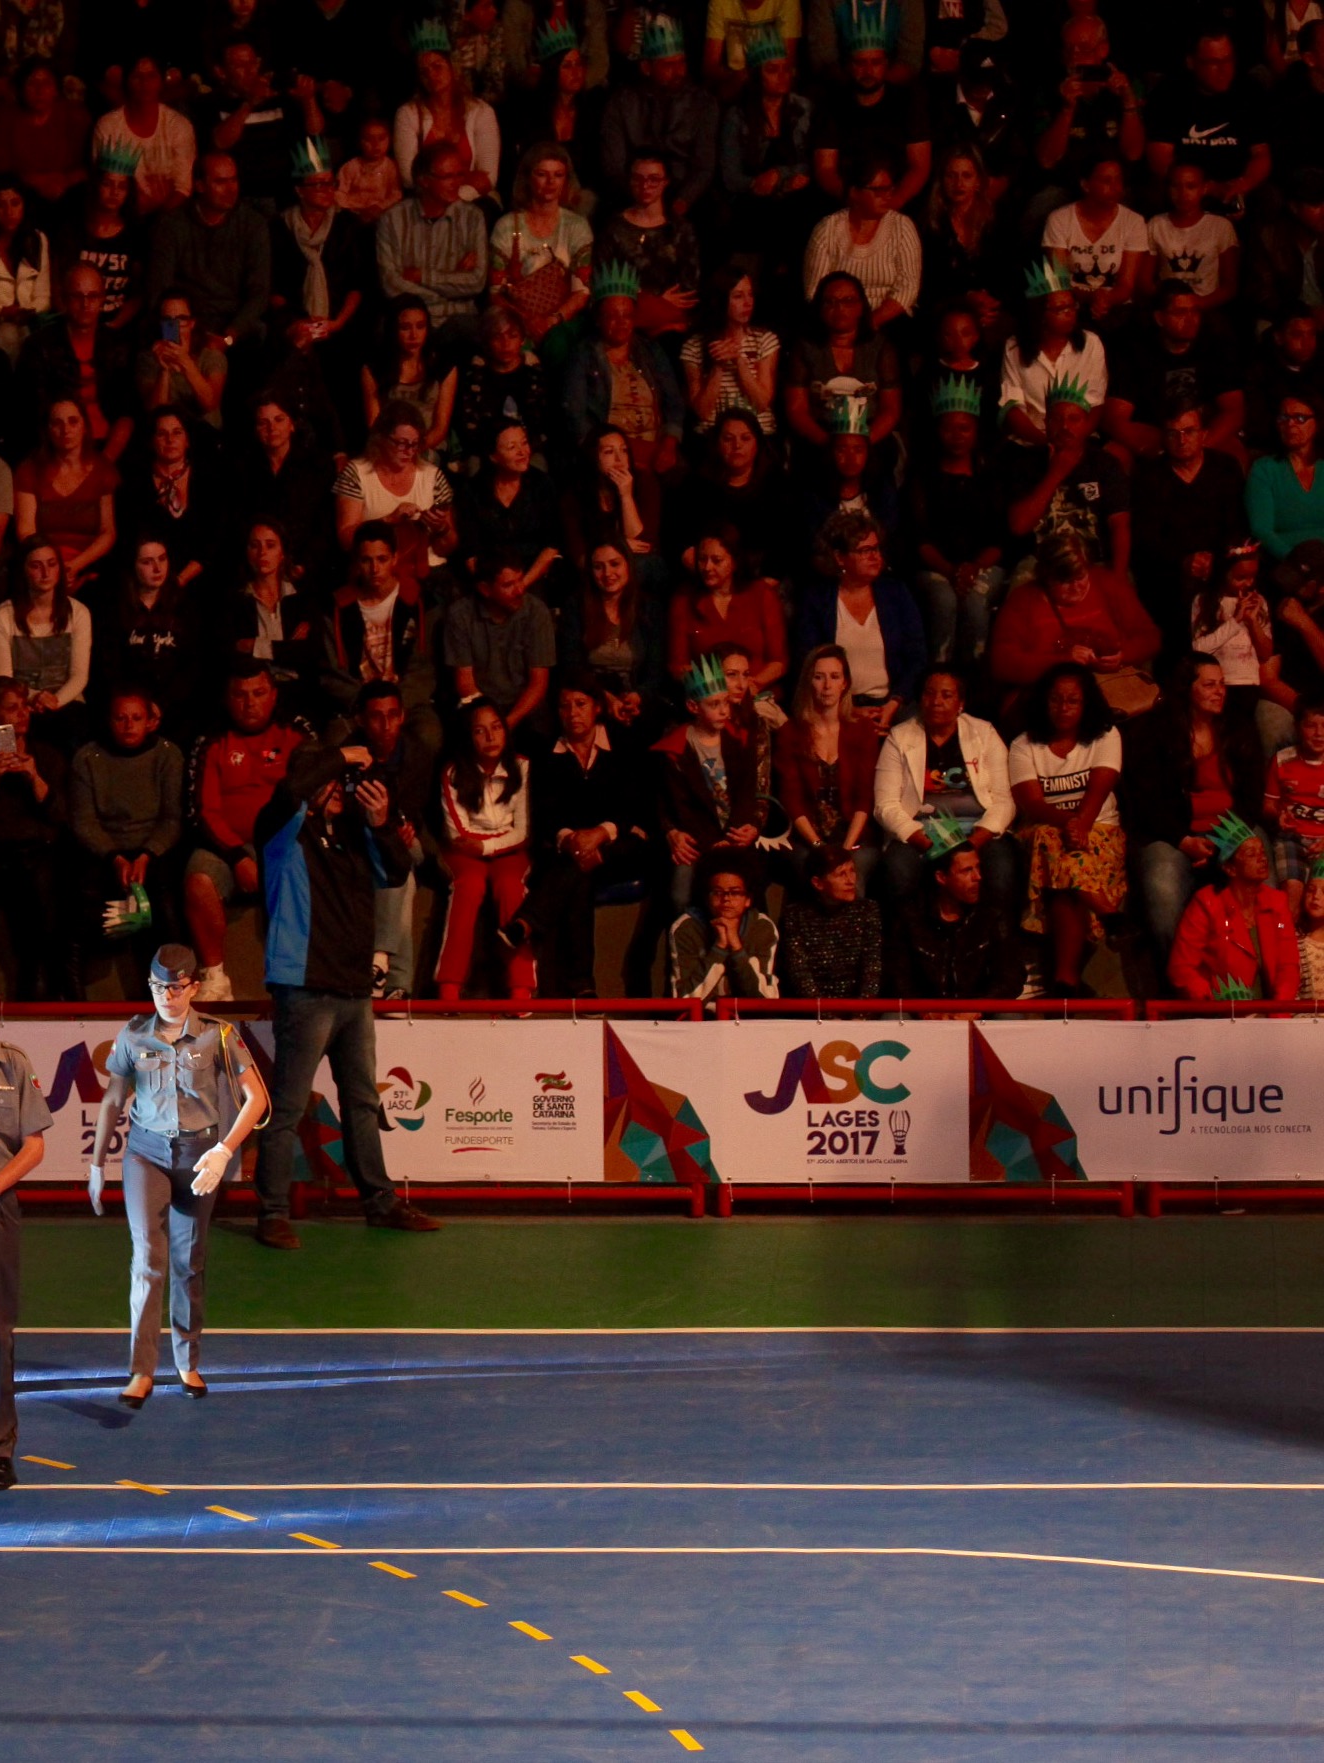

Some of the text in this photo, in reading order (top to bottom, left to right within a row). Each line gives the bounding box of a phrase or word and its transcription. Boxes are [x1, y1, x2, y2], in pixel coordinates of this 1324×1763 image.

[743, 1039, 912, 1115] JASC
[532, 1095, 575, 1103] GOVERNO
[1098, 1055, 1283, 1135] unifique
[387, 1100, 413, 1110] JASC
[445, 1108, 513, 1125] Fesporte
[807, 1110, 880, 1127] LAGES
[1199, 1125, 1251, 1134] TECNOLOGIA
[1254, 1125, 1271, 1133] NOS
[1275, 1125, 1312, 1133] CONECTA
[445, 1136, 514, 1145] FUNDESPORTE
[807, 1130, 880, 1155] 2017
